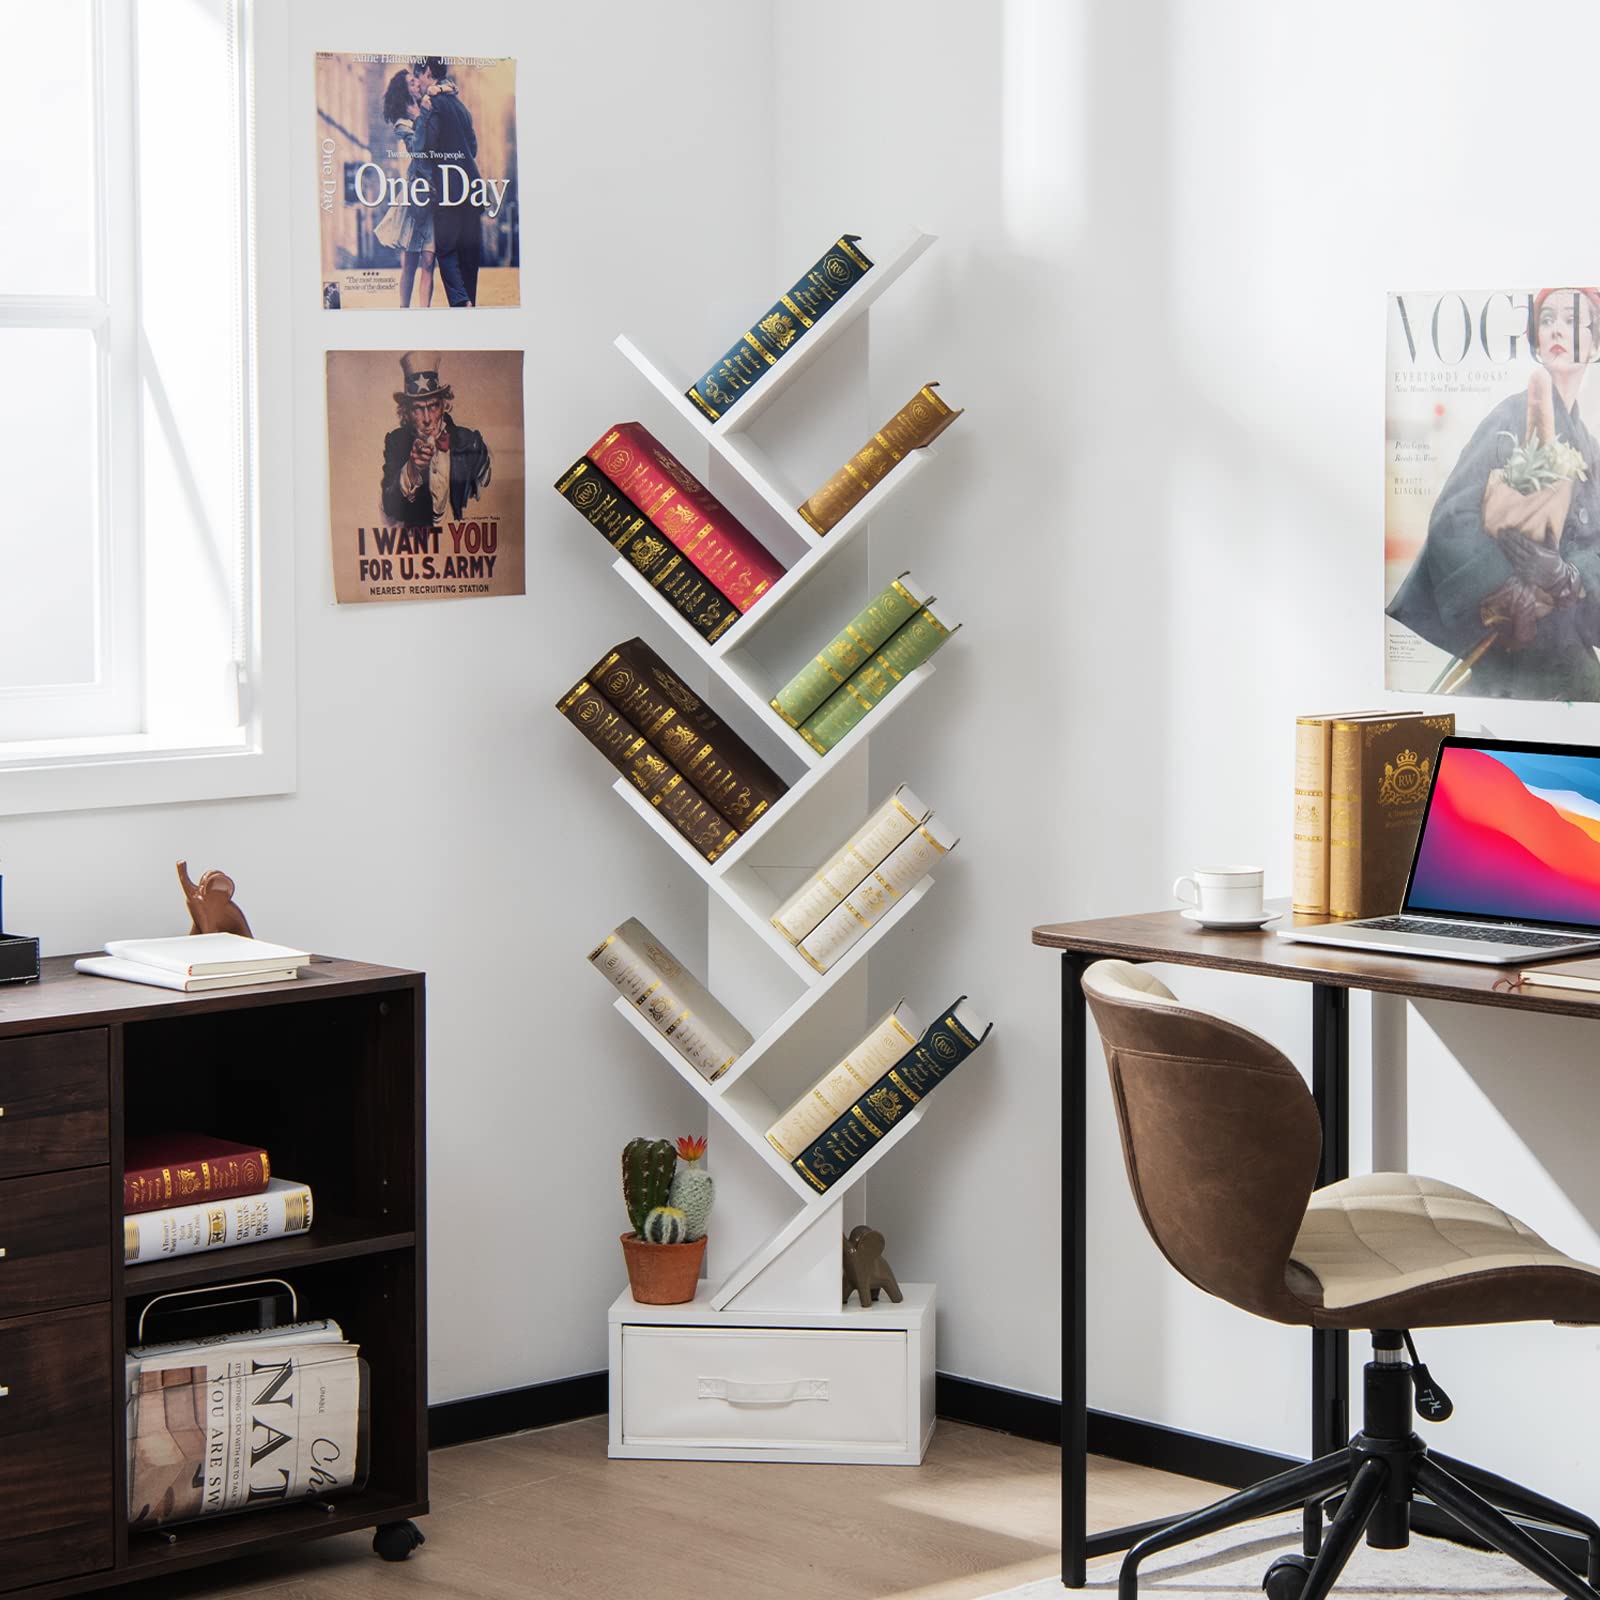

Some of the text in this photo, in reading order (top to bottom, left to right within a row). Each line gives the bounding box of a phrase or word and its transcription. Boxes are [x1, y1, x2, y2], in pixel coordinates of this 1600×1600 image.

[428, 150, 442, 158] Two
[321, 138, 337, 214] One Day
[354, 163, 510, 218] One Day
[830, 262, 846, 277] RW
[578, 485, 594, 501] RW
[358, 522, 498, 556] I WANT YOU
[360, 559, 393, 582] FOR
[370, 584, 489, 596] NEAREST RECRUITING STATION
[611, 676, 626, 691] RW
[580, 704, 596, 721] RW
[1399, 774, 1414, 786] RW
[937, 1040, 953, 1055] RW
[210, 1375, 224, 1418] YOU
[235, 1411, 242, 1423] TO
[235, 1424, 242, 1436] DO
[210, 1428, 224, 1468] ARE
[233, 1456, 240, 1469] ME
[232, 1470, 240, 1480] TO
